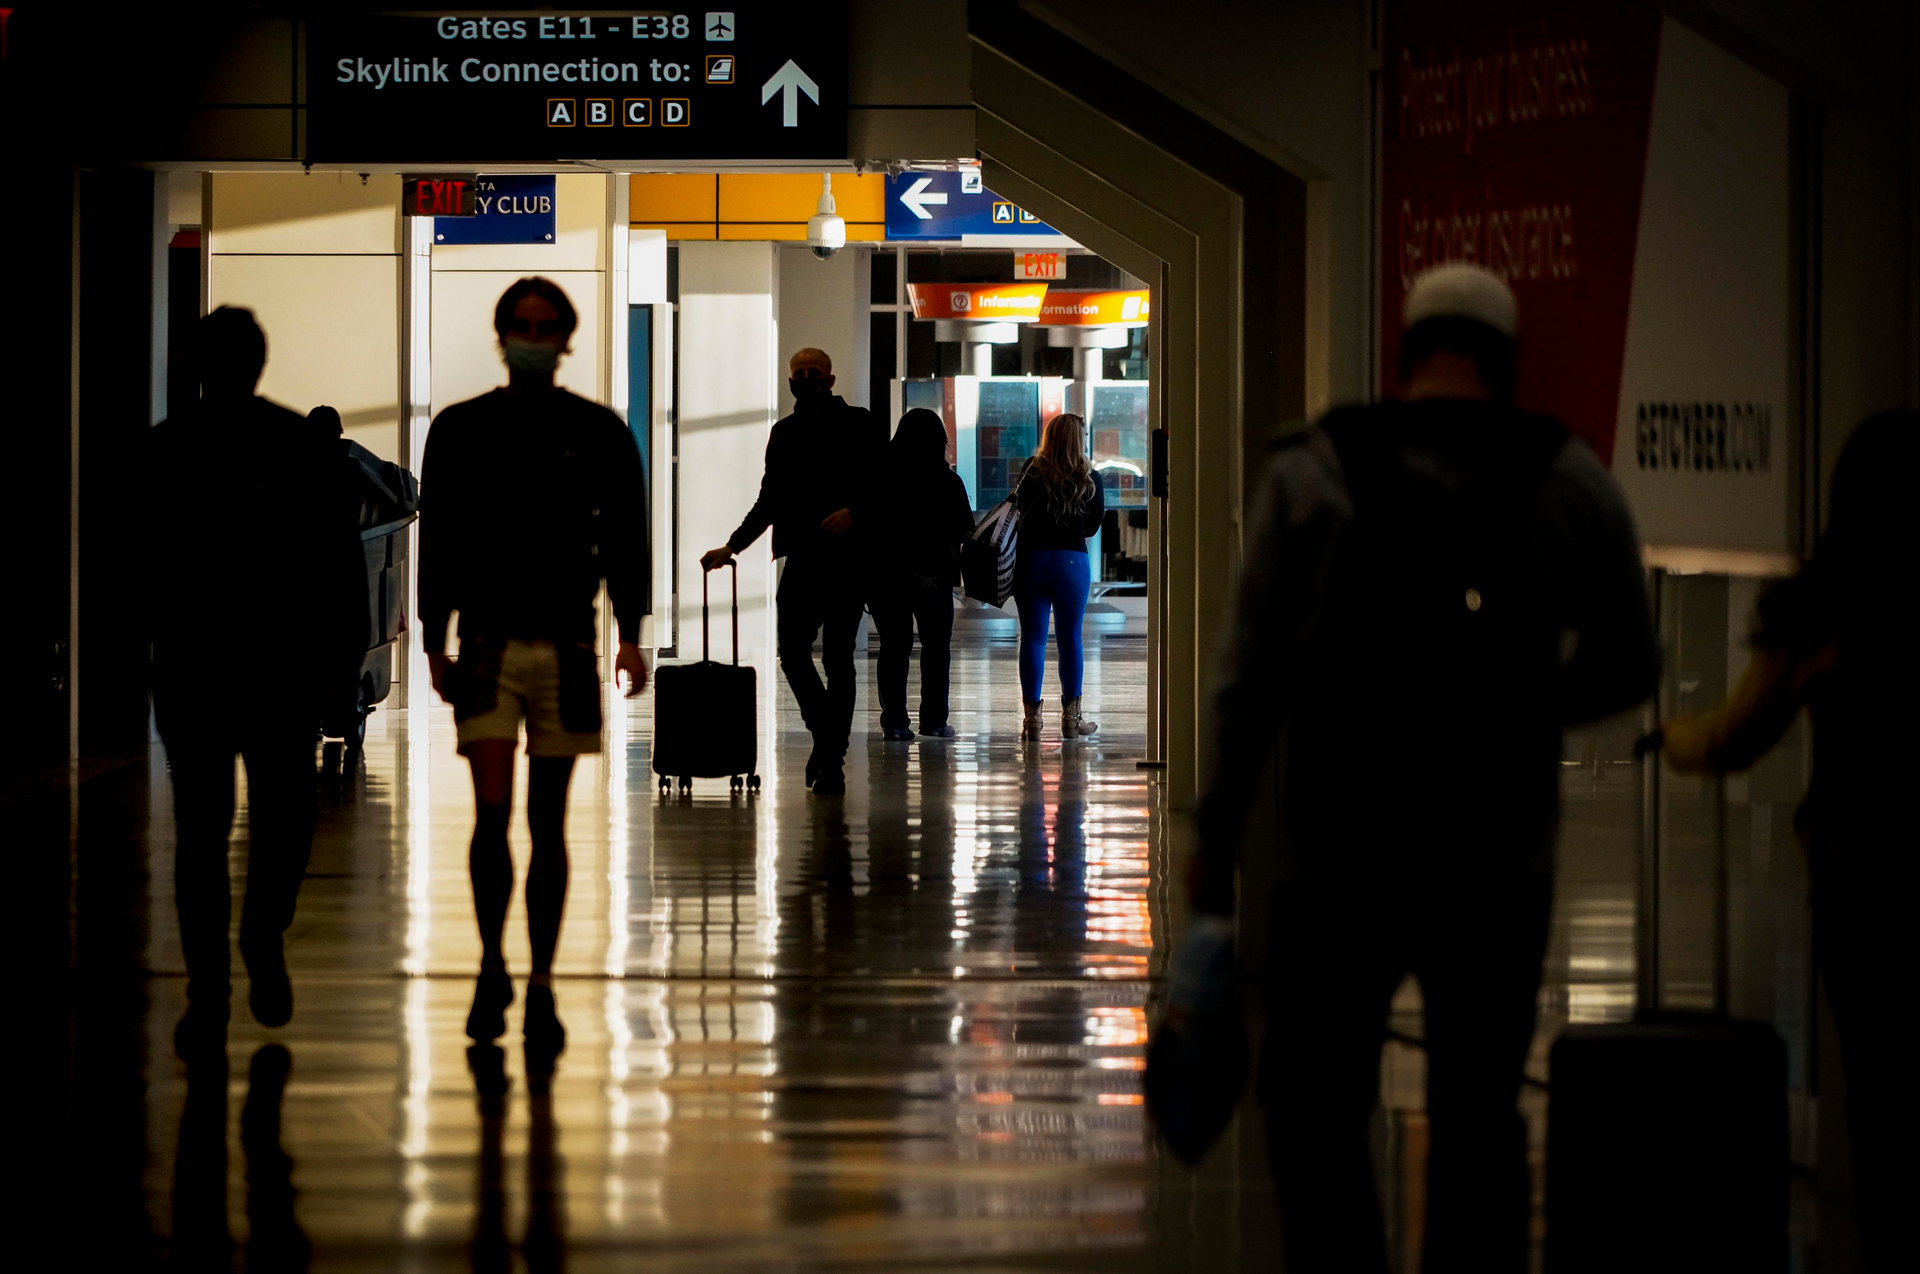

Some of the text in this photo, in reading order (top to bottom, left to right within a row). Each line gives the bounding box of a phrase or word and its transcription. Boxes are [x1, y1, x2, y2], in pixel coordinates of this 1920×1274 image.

[437, 15, 527, 40] Gates
[538, 15, 597, 40] E11
[632, 15, 691, 40] E38
[336, 57, 692, 91] Skylink Connection to:
[551, 102, 685, 123] A B C D
[1401, 47, 1461, 138] Protect
[1466, 55, 1504, 156] your
[415, 179, 467, 214] EXIT
[497, 195, 551, 215] CLUB
[996, 205, 1011, 220] A
[1025, 253, 1058, 277] EXIT
